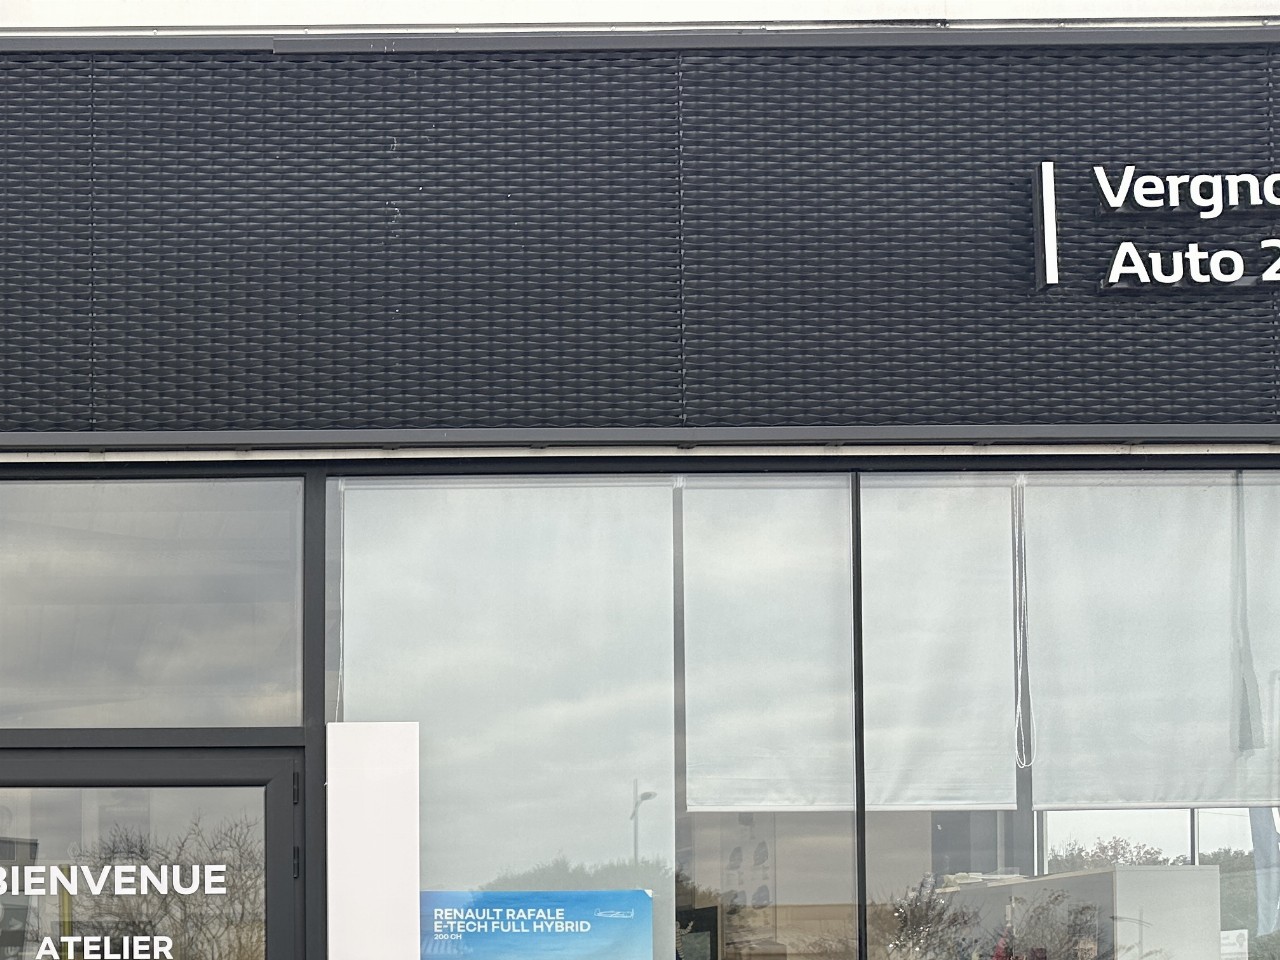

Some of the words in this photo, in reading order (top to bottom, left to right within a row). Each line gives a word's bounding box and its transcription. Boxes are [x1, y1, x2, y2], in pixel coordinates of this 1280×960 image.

[1108, 242, 1245, 284] Auto
[433, 908, 503, 920] RENAULT
[506, 908, 565, 920] RAFALE
[433, 920, 488, 933] E-TECH
[491, 920, 530, 933] FULL
[532, 920, 591, 933] HYBRID
[35, 935, 174, 960] ATELIER
